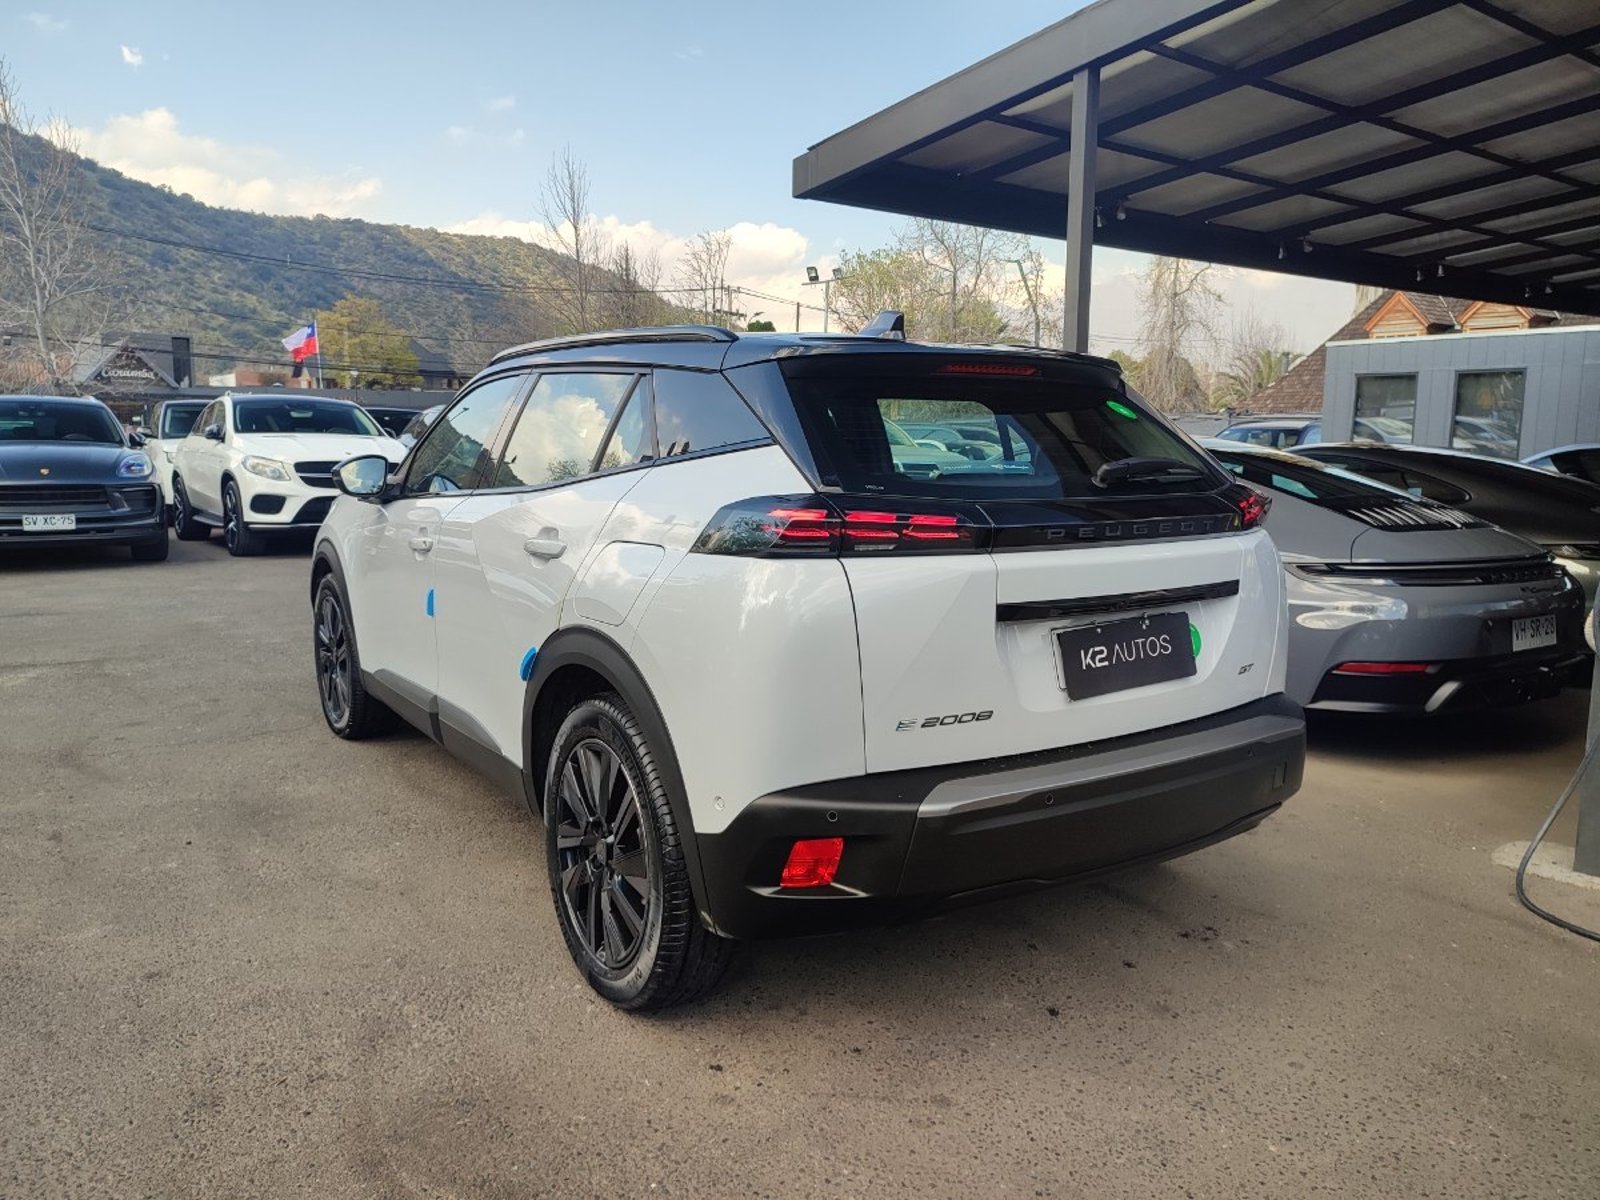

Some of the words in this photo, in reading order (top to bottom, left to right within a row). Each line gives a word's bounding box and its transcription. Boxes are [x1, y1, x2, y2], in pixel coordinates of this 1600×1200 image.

[1046, 519, 1217, 541] PEUGEOT
[1080, 646, 1109, 670] K2
[1111, 634, 1172, 665] AUTOS
[1238, 662, 1254, 675] GT
[920, 709, 994, 729] 2008
